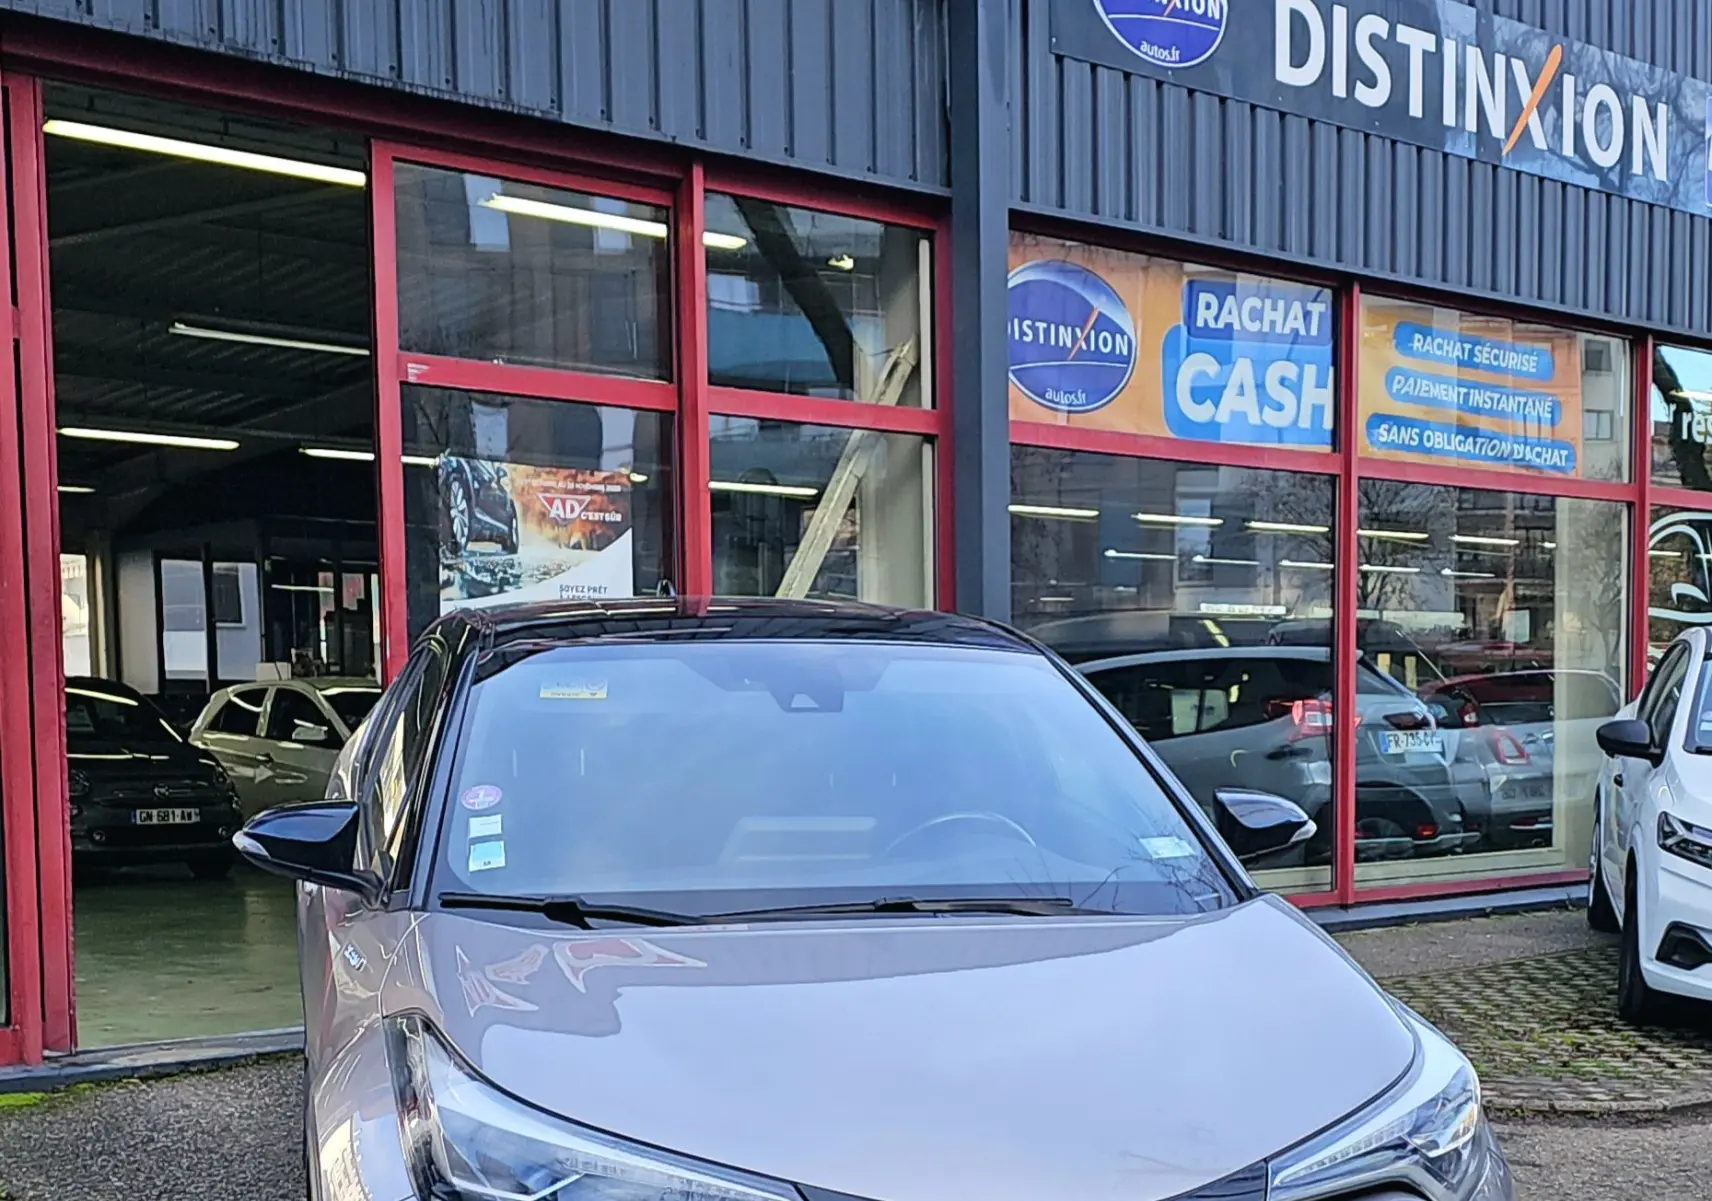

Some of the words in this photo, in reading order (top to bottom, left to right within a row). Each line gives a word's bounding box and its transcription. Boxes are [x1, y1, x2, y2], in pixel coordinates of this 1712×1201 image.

[1140, 41, 1180, 62] autos.fr
[1275, 0, 1668, 182] DISTINXION
[1196, 292, 1326, 337] RACHAT
[1008, 316, 1128, 358] ISTINXION
[1412, 333, 1472, 361] RACHAT
[1474, 339, 1538, 373] SÉCURISÉ
[1045, 387, 1087, 405] autos.fr
[1176, 352, 1334, 431] CASH
[1392, 375, 1468, 405] PAIEMENT
[1469, 390, 1553, 418] INSTANTANÉ
[1378, 423, 1420, 446] SANS
[1423, 430, 1511, 458] OBLIGATION
[549, 498, 580, 519] AD
[559, 584, 586, 593] SOYEZ
